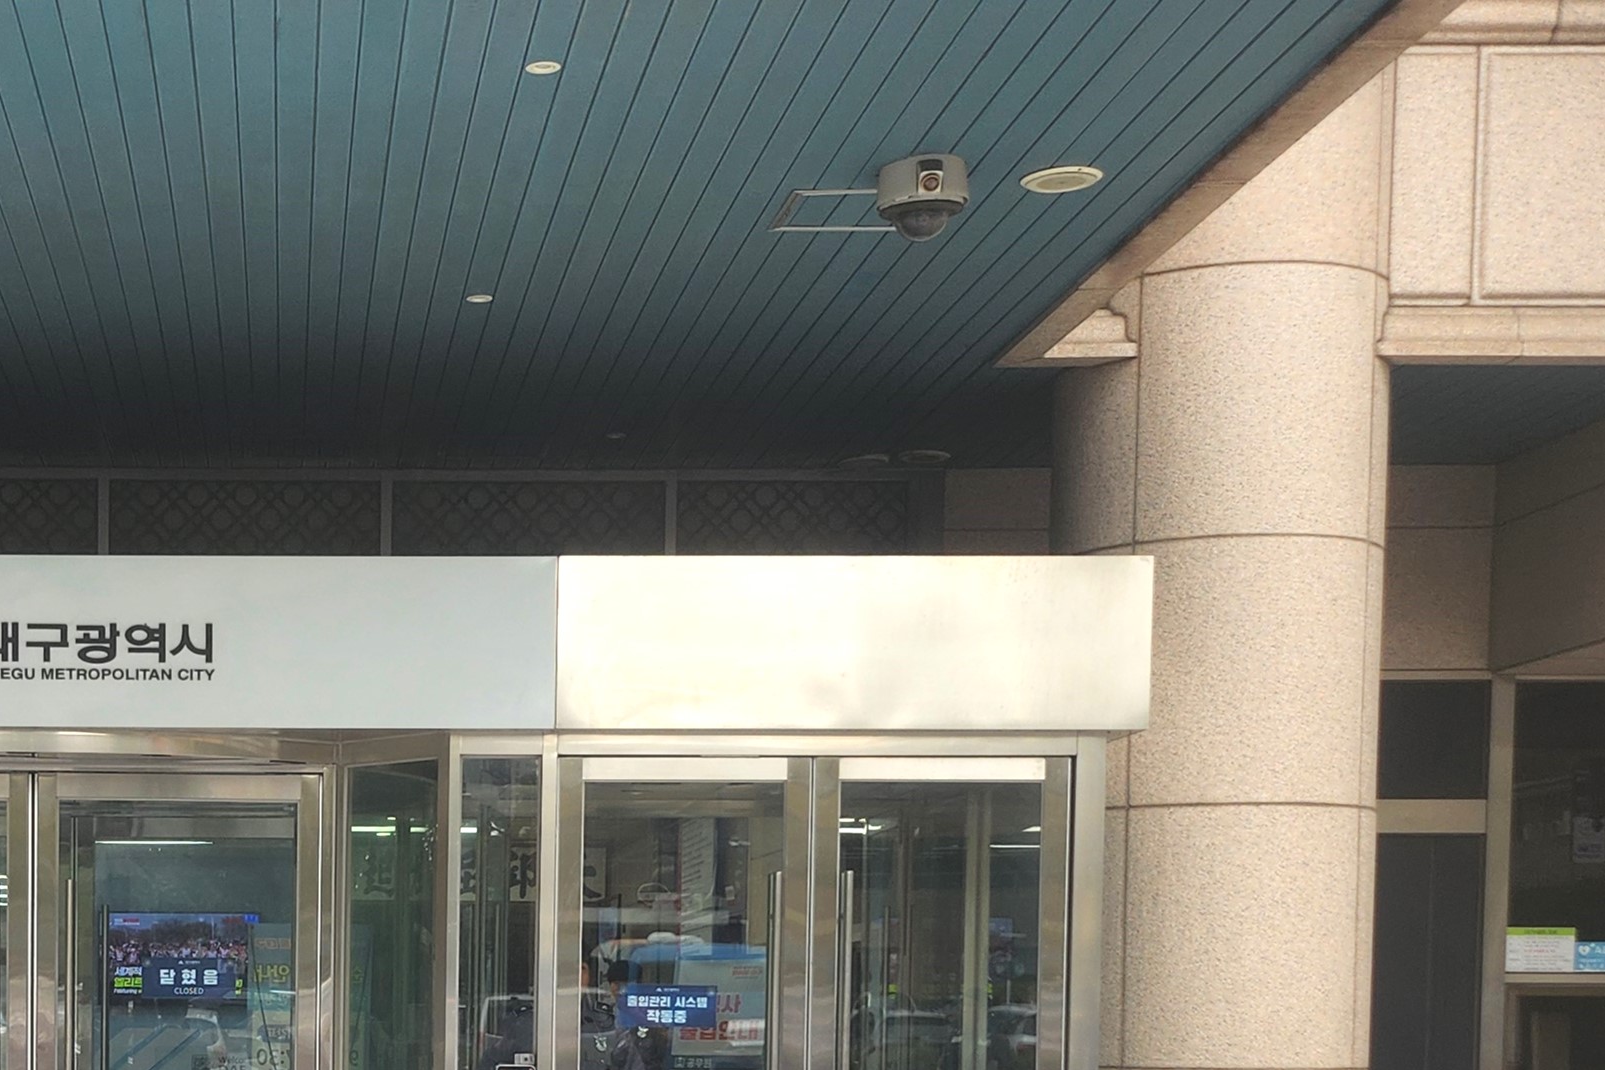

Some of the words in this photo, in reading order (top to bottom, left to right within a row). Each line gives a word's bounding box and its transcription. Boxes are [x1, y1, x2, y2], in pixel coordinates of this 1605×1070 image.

[40, 667, 170, 682] METROPOLITAN
[177, 667, 216, 682] CITY
[174, 987, 204, 995] CLOSED
[627, 995, 671, 1008] 출입관리
[674, 995, 708, 1009] 시스템
